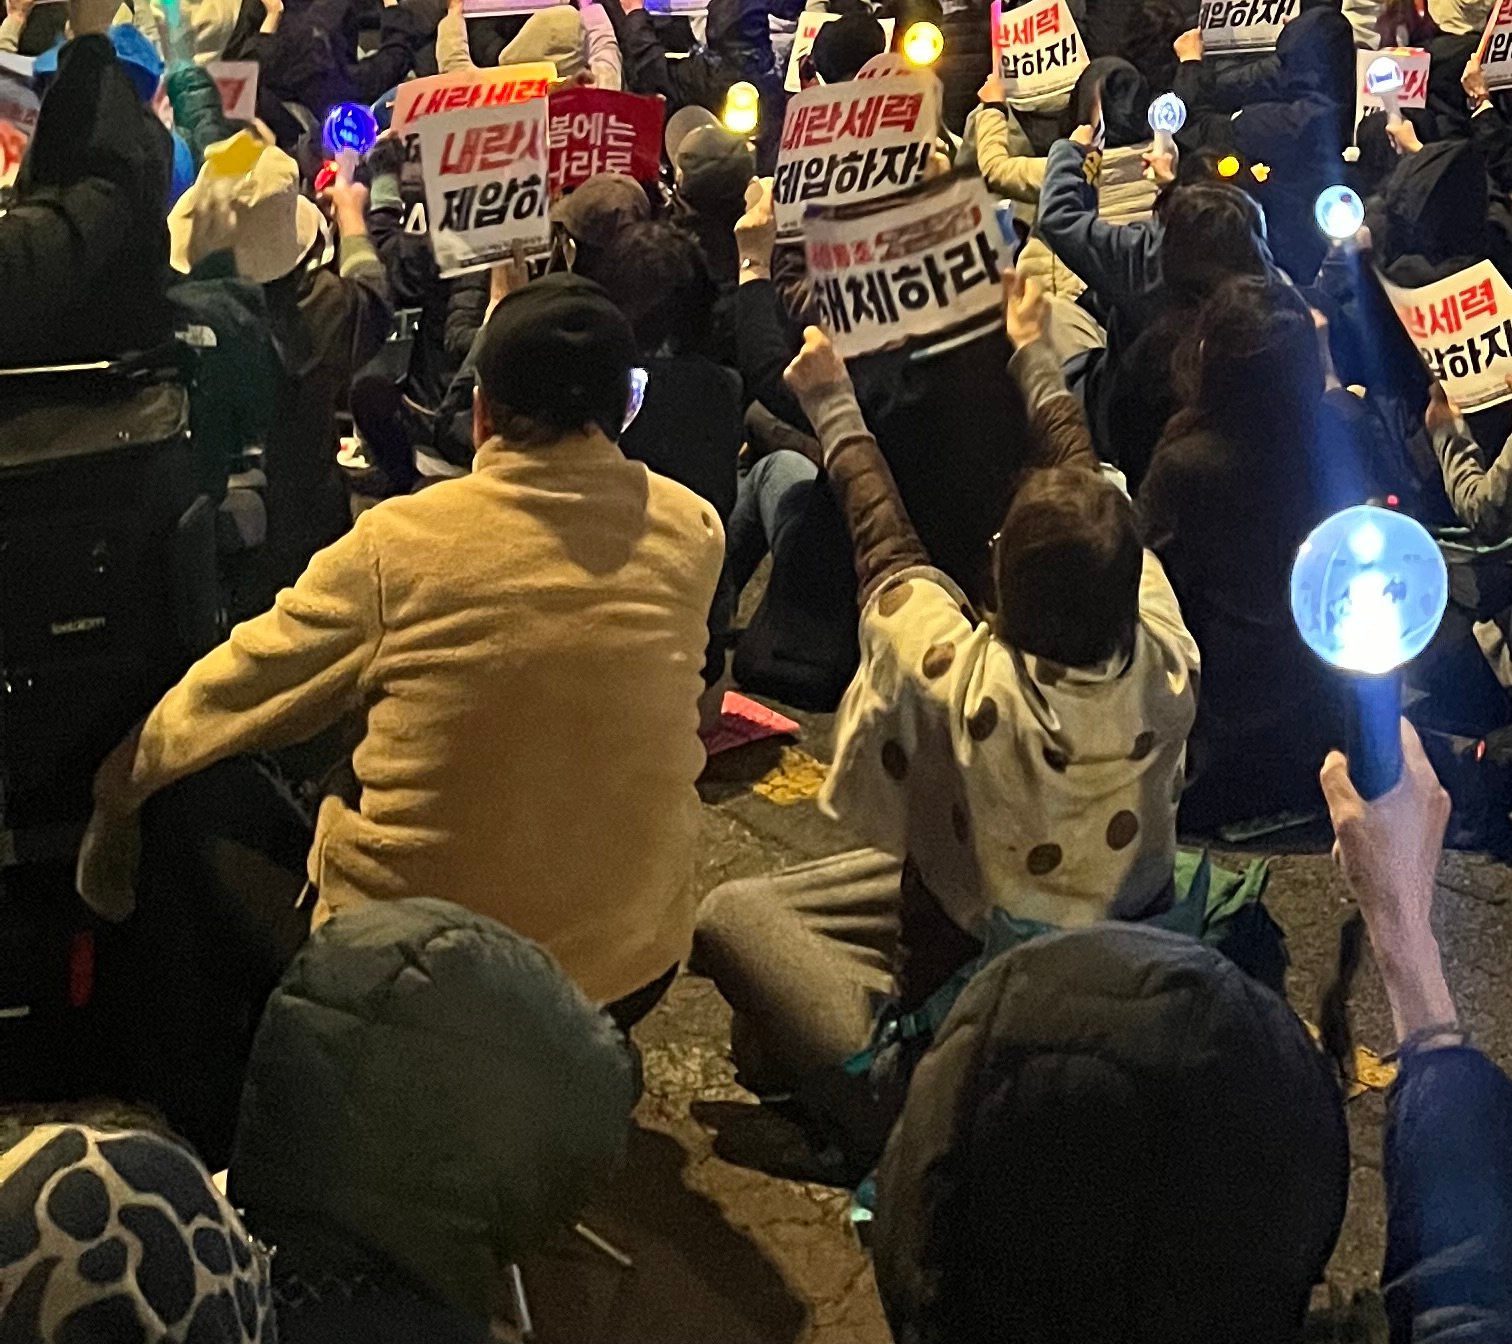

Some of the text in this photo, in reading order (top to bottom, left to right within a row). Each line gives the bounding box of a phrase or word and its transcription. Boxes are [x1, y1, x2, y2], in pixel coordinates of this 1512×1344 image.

[1001, 33, 1078, 80] 압하자!
[782, 92, 925, 151] 내란세력
[773, 141, 932, 205] 제압하자!
